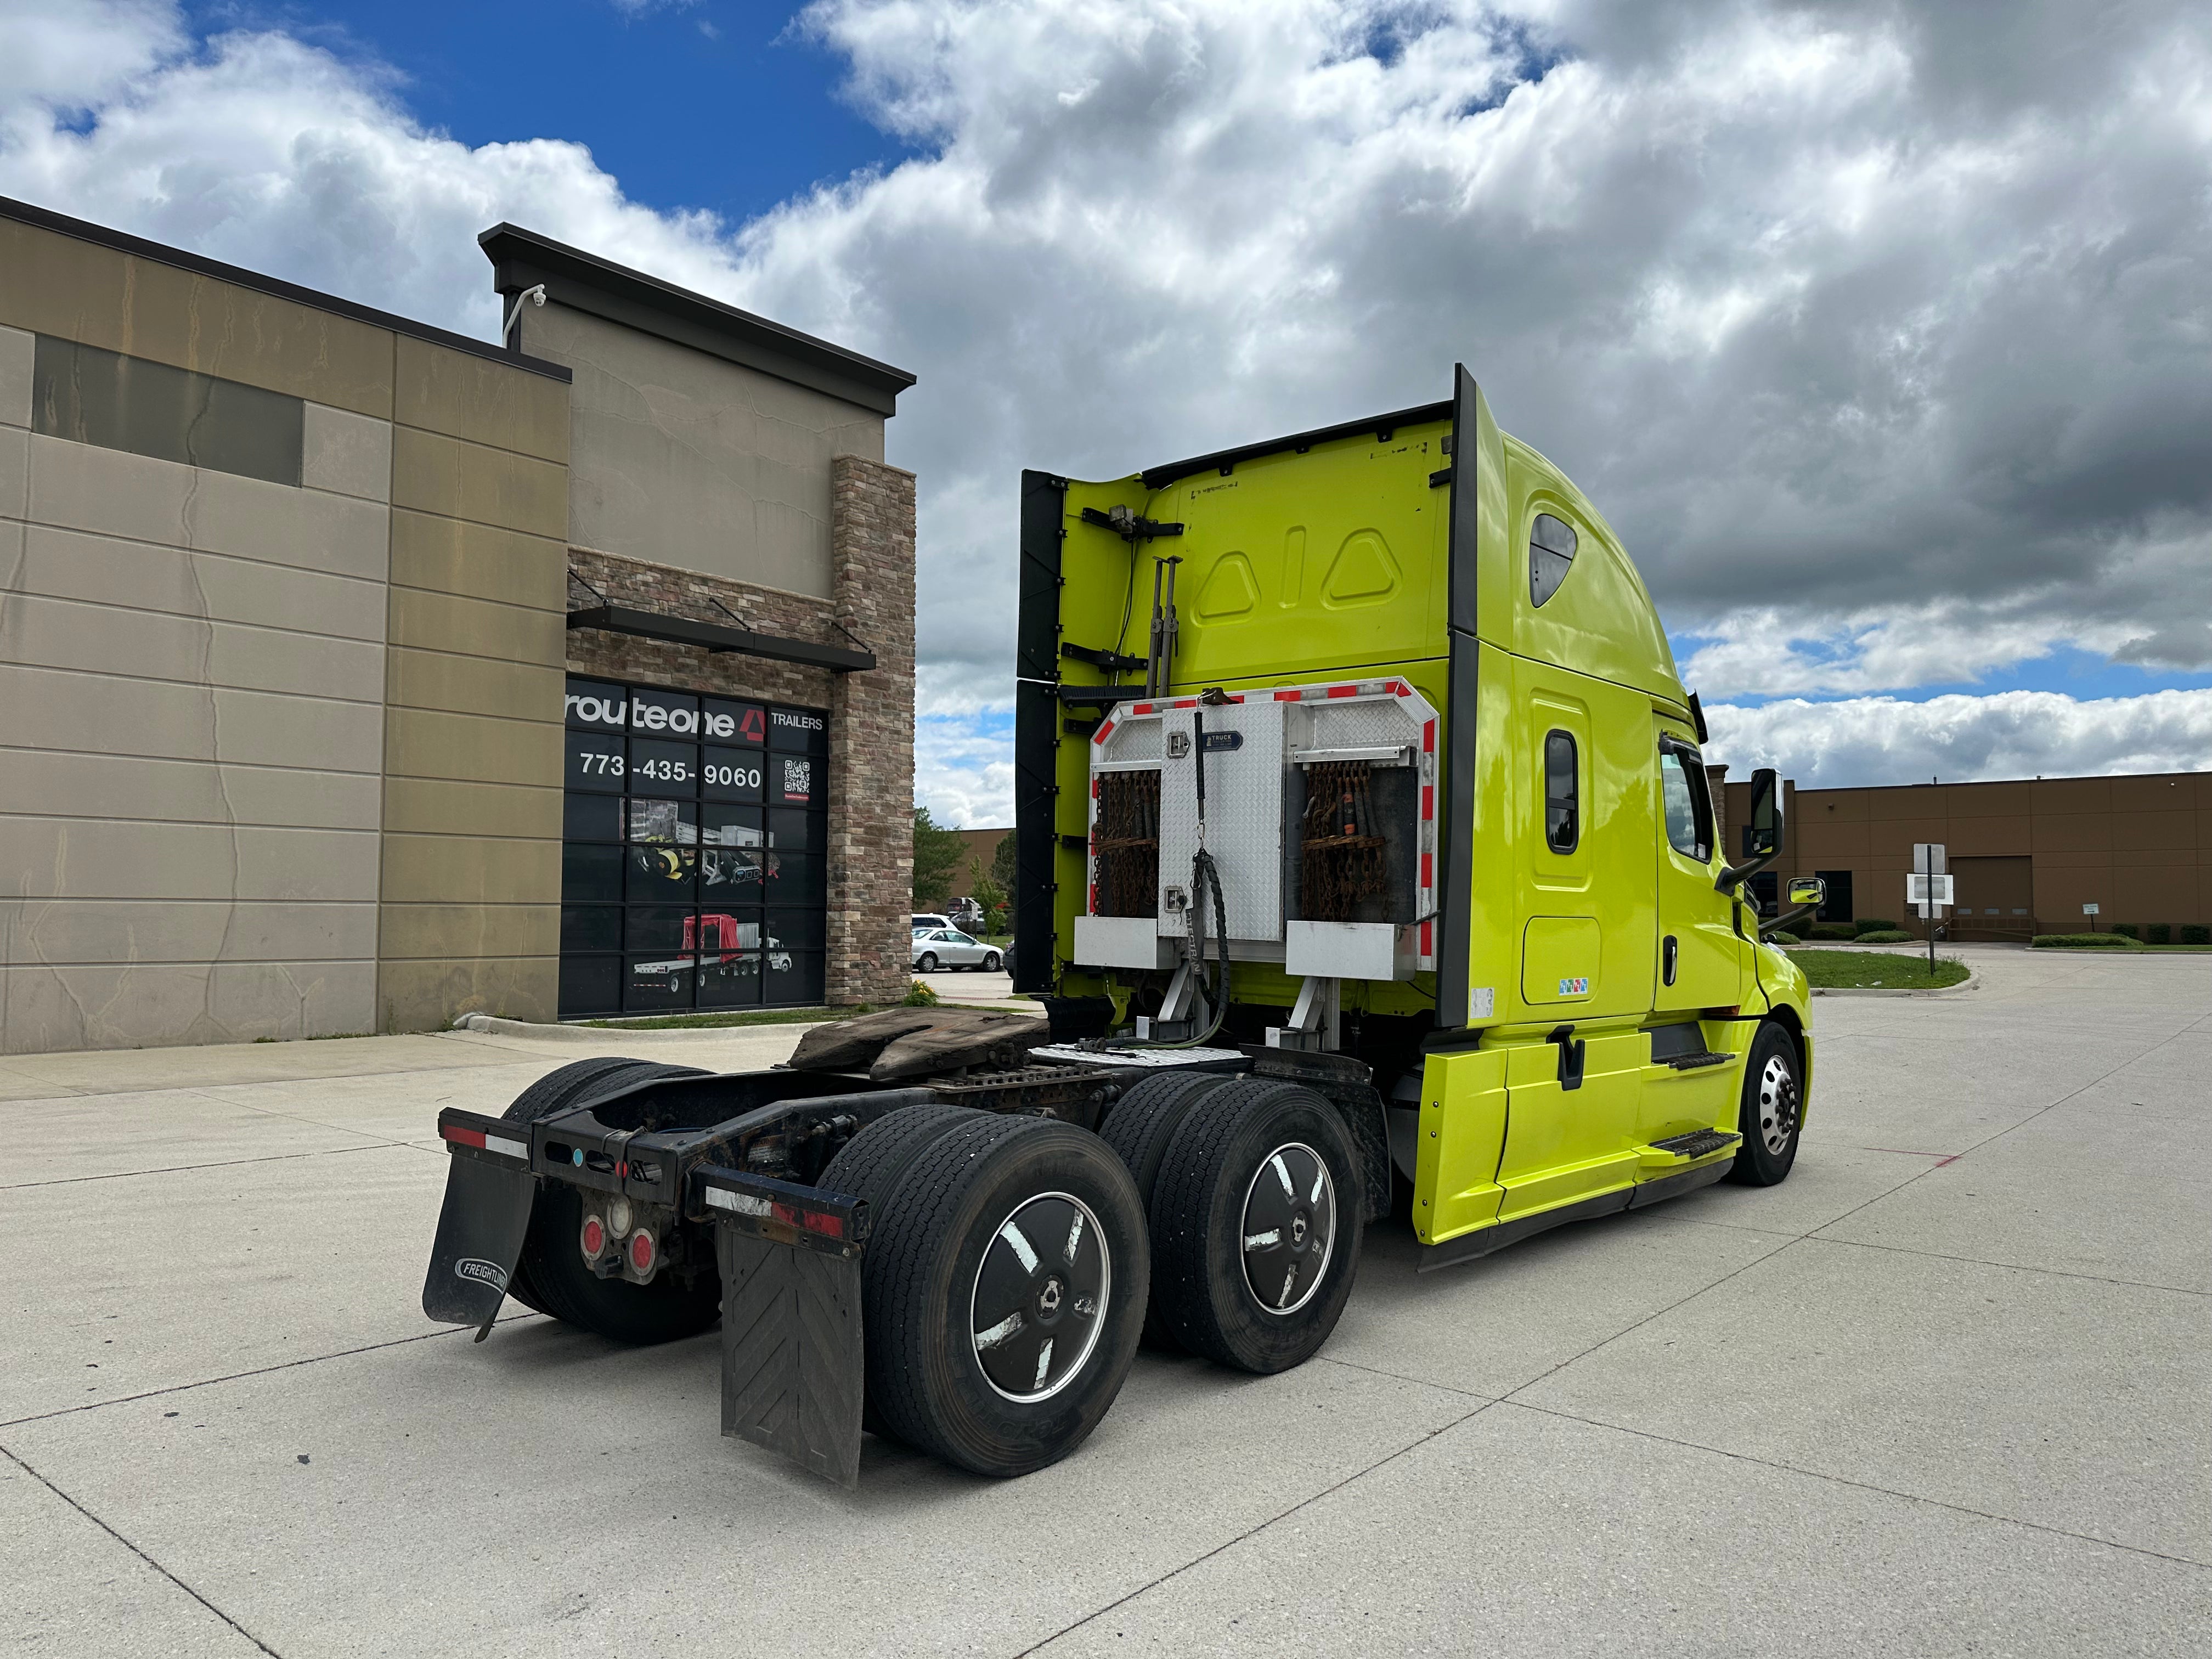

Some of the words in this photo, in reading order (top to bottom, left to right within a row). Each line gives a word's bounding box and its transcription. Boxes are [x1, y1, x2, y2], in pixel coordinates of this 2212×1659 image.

[565, 693, 735, 737] routeone
[771, 712, 823, 730] TRAILERS
[1187, 922, 1200, 972] TECTRAN
[464, 1263, 506, 1288] FREIGHTLINER
